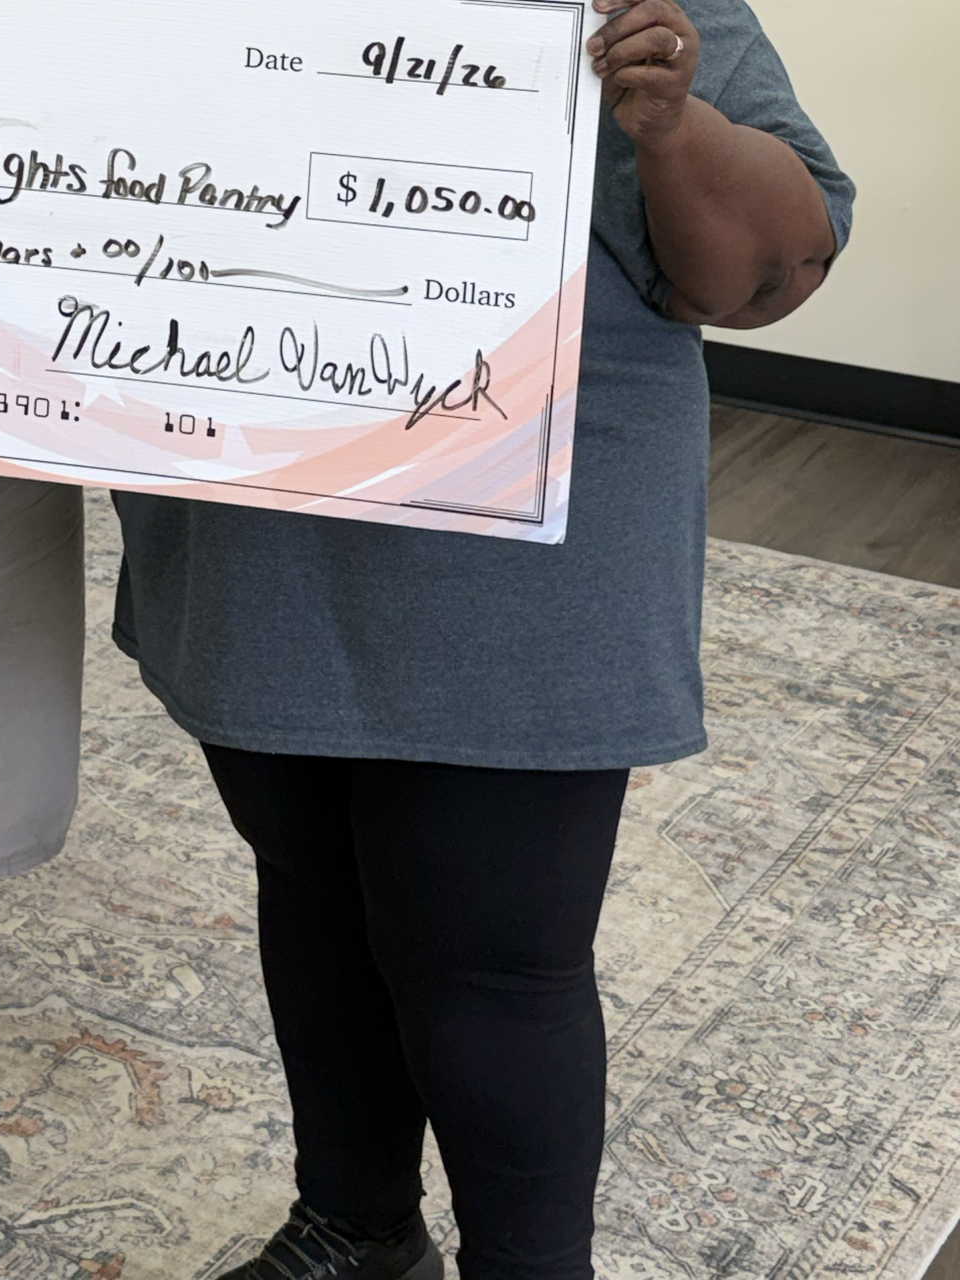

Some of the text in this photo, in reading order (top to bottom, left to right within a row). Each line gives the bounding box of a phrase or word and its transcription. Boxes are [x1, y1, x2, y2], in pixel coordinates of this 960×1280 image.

[245, 47, 303, 73] Date
[178, 162, 301, 229] Pantry
[337, 171, 358, 207] $
[368, 177, 536, 223] 1,050.00
[425, 278, 516, 309] Dollars
[51, 296, 270, 384] Michael
